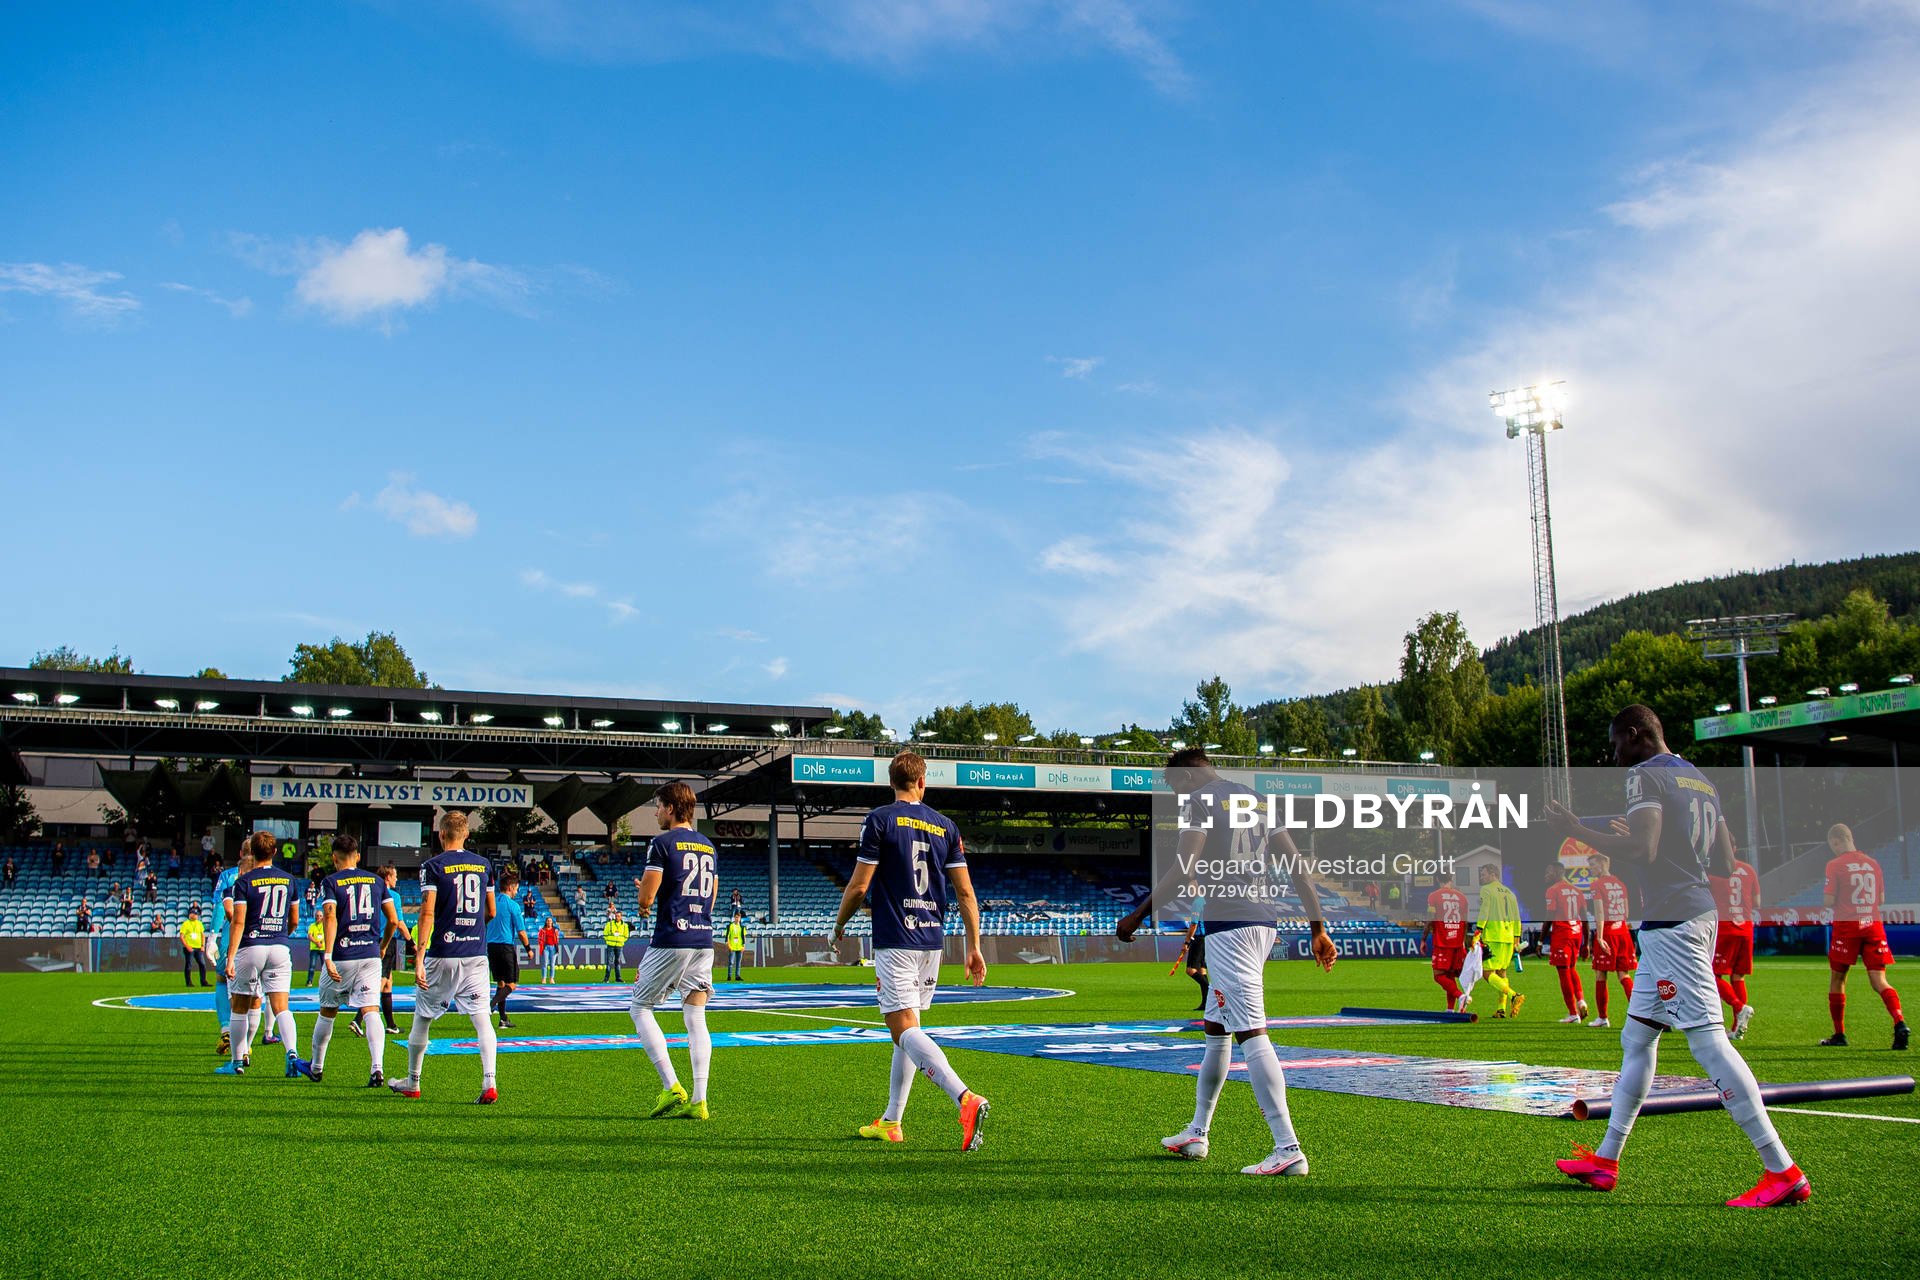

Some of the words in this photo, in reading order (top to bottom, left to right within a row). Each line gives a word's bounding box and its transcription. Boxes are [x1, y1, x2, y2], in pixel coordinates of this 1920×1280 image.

[1860, 694, 1891, 713] KIWI
[1750, 711, 1778, 728] KIWI
[803, 762, 826, 778] DNB
[969, 768, 991, 783] DNB
[1048, 770, 1069, 786] DNB
[282, 782, 423, 801] MARIENLYST
[432, 785, 527, 803] STADION
[1689, 798, 1716, 857] 10
[681, 852, 714, 898] 26
[911, 840, 930, 896] 5
[1846, 863, 1874, 872] BA
[453, 873, 481, 914] 19
[1729, 876, 1742, 906] 3
[1851, 873, 1876, 905] 29
[258, 885, 288, 919] 70
[346, 884, 375, 921] 14
[1443, 901, 1461, 923] 23
[1567, 895, 1579, 920] 11
